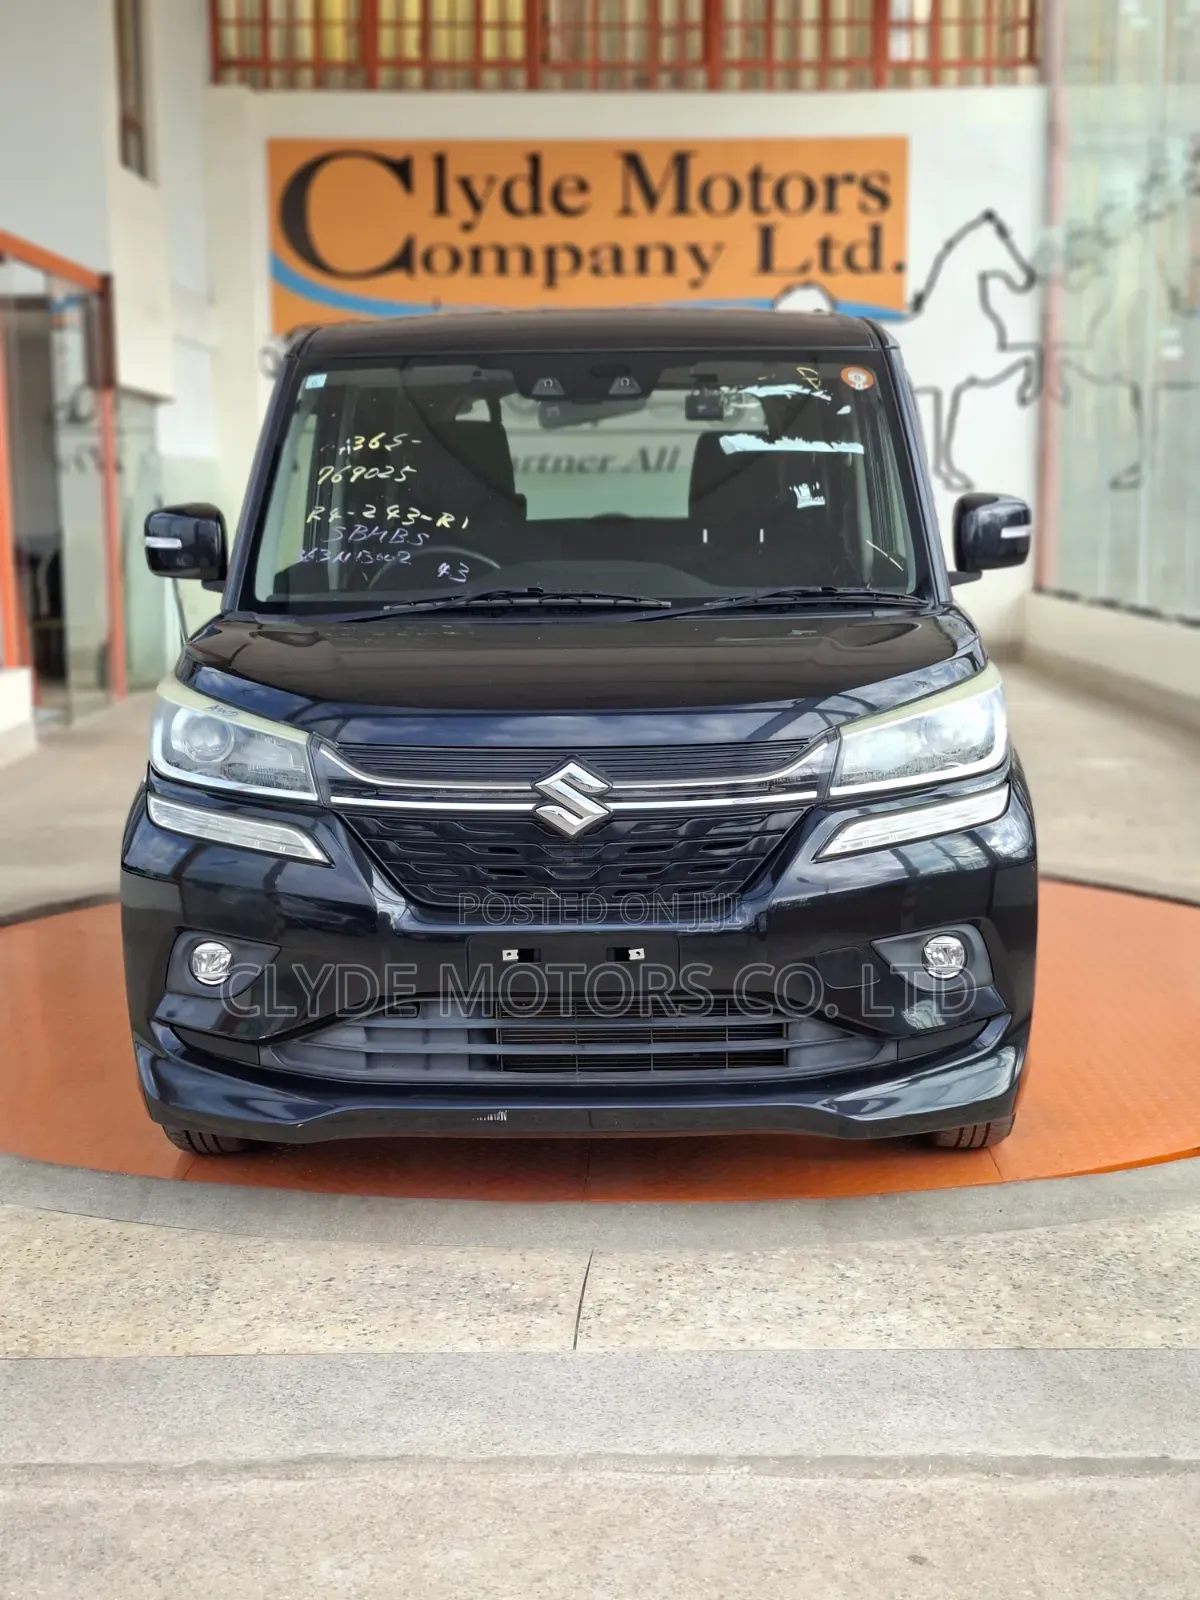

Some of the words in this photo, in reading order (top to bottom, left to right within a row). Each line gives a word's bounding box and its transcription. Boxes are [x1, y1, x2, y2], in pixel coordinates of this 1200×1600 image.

[616, 149, 893, 219] Motors
[755, 221, 907, 276] Ltd.
[620, 445, 682, 474] All
